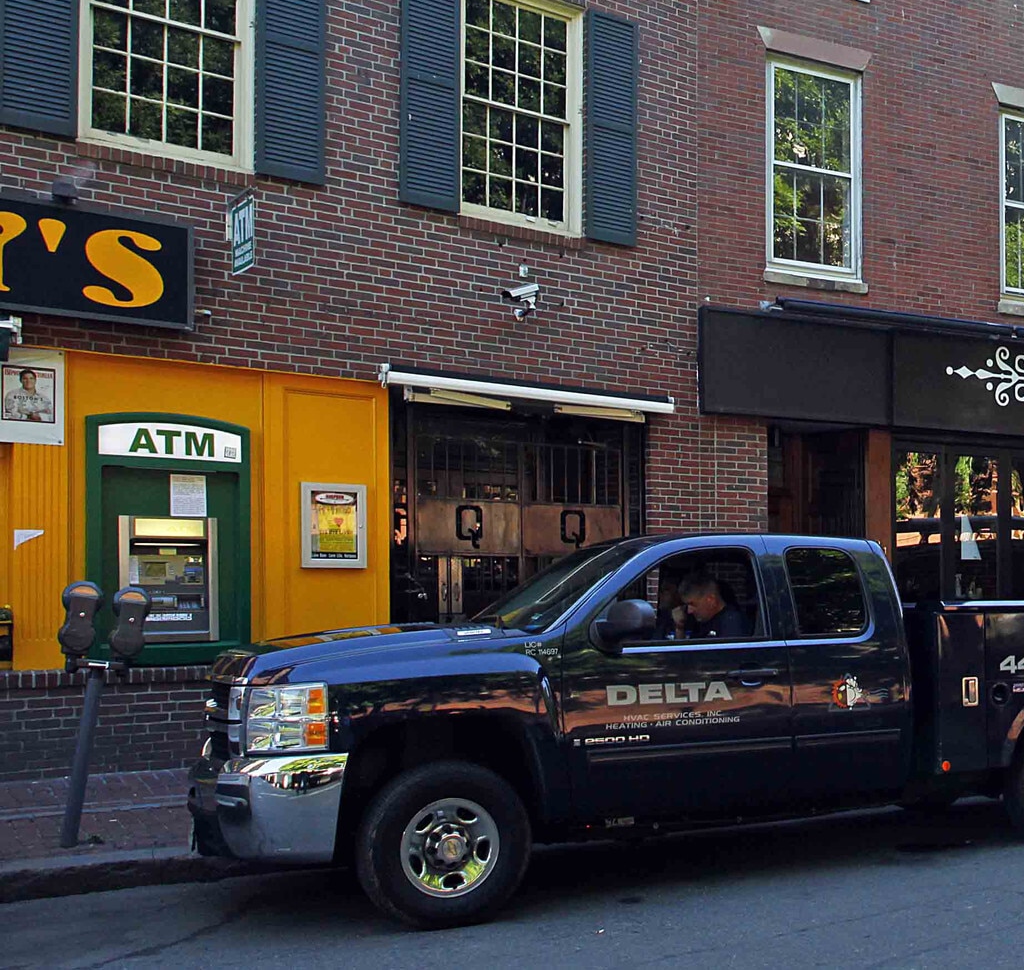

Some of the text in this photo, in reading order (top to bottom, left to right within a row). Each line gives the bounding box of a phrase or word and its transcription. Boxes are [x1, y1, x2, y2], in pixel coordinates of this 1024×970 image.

[233, 203, 253, 247] ATM
[129, 428, 215, 458] ATM
[456, 505, 483, 549] Q
[560, 509, 587, 548] Q
[606, 681, 733, 706] DELTA
[605, 716, 740, 731] HEATING AIR CONDITIONING
[624, 714, 649, 722] HVAC
[629, 734, 650, 742] HD
